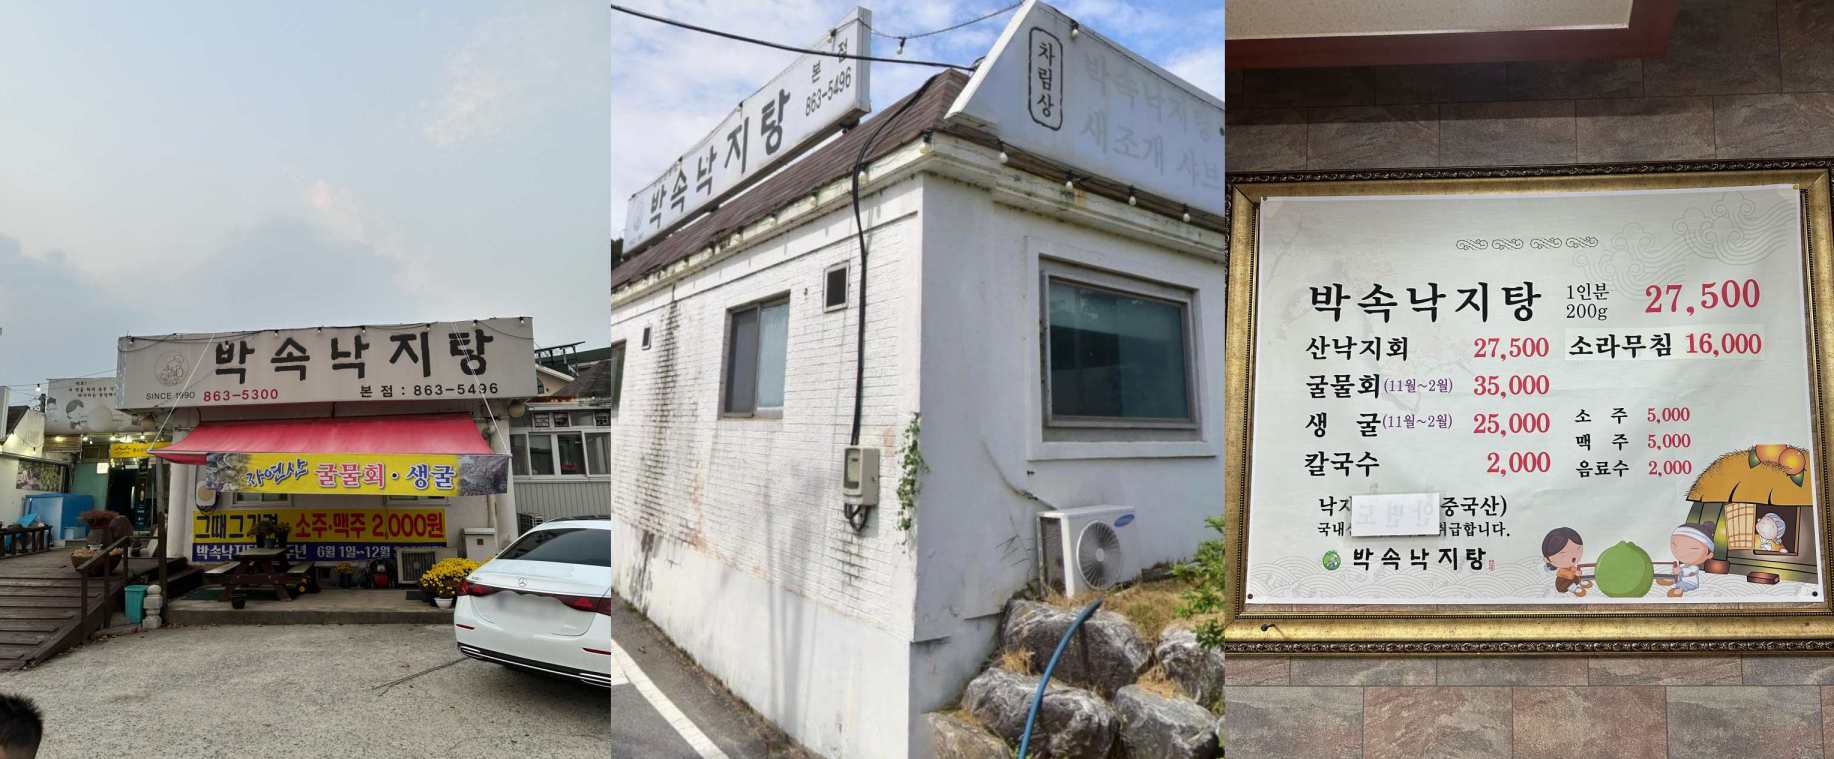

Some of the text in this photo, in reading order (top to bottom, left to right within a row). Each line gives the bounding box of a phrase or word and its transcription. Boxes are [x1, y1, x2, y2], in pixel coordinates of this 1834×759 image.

[806, 66, 851, 116] 863-5496
[1037, 42, 1056, 118] 차림상
[649, 88, 791, 229] 박속낙지탕
[1309, 278, 1761, 323] 박속낙지탕 1인분 27,500
[1566, 303, 1608, 321] 200g
[215, 329, 494, 385] 박속낙지탕
[1305, 333, 1762, 362] 산낙지회 27,500 소라무침 16,000
[145, 392, 172, 401] SINCE
[203, 388, 279, 402] 863-5300
[413, 382, 498, 396] 863-5496
[1305, 373, 1550, 399] 굴물회 (11월~2월) 35,000
[1382, 413, 1453, 431] (11월~2월)
[1473, 412, 1551, 437] 25,000
[1647, 407, 1690, 424] 5,000
[1647, 433, 1691, 450] 5,000
[246, 458, 309, 487] 자연산
[315, 463, 385, 489] 굴물회
[406, 463, 456, 490] 생굴
[1304, 451, 1551, 477] 칼국수 2,000
[1575, 460, 1692, 478] 음료수 2,000
[372, 512, 445, 539] 2,000원
[1317, 521, 1352, 537] 국내
[317, 545, 336, 558] 6월
[1353, 547, 1487, 571] 박속낙지탕
